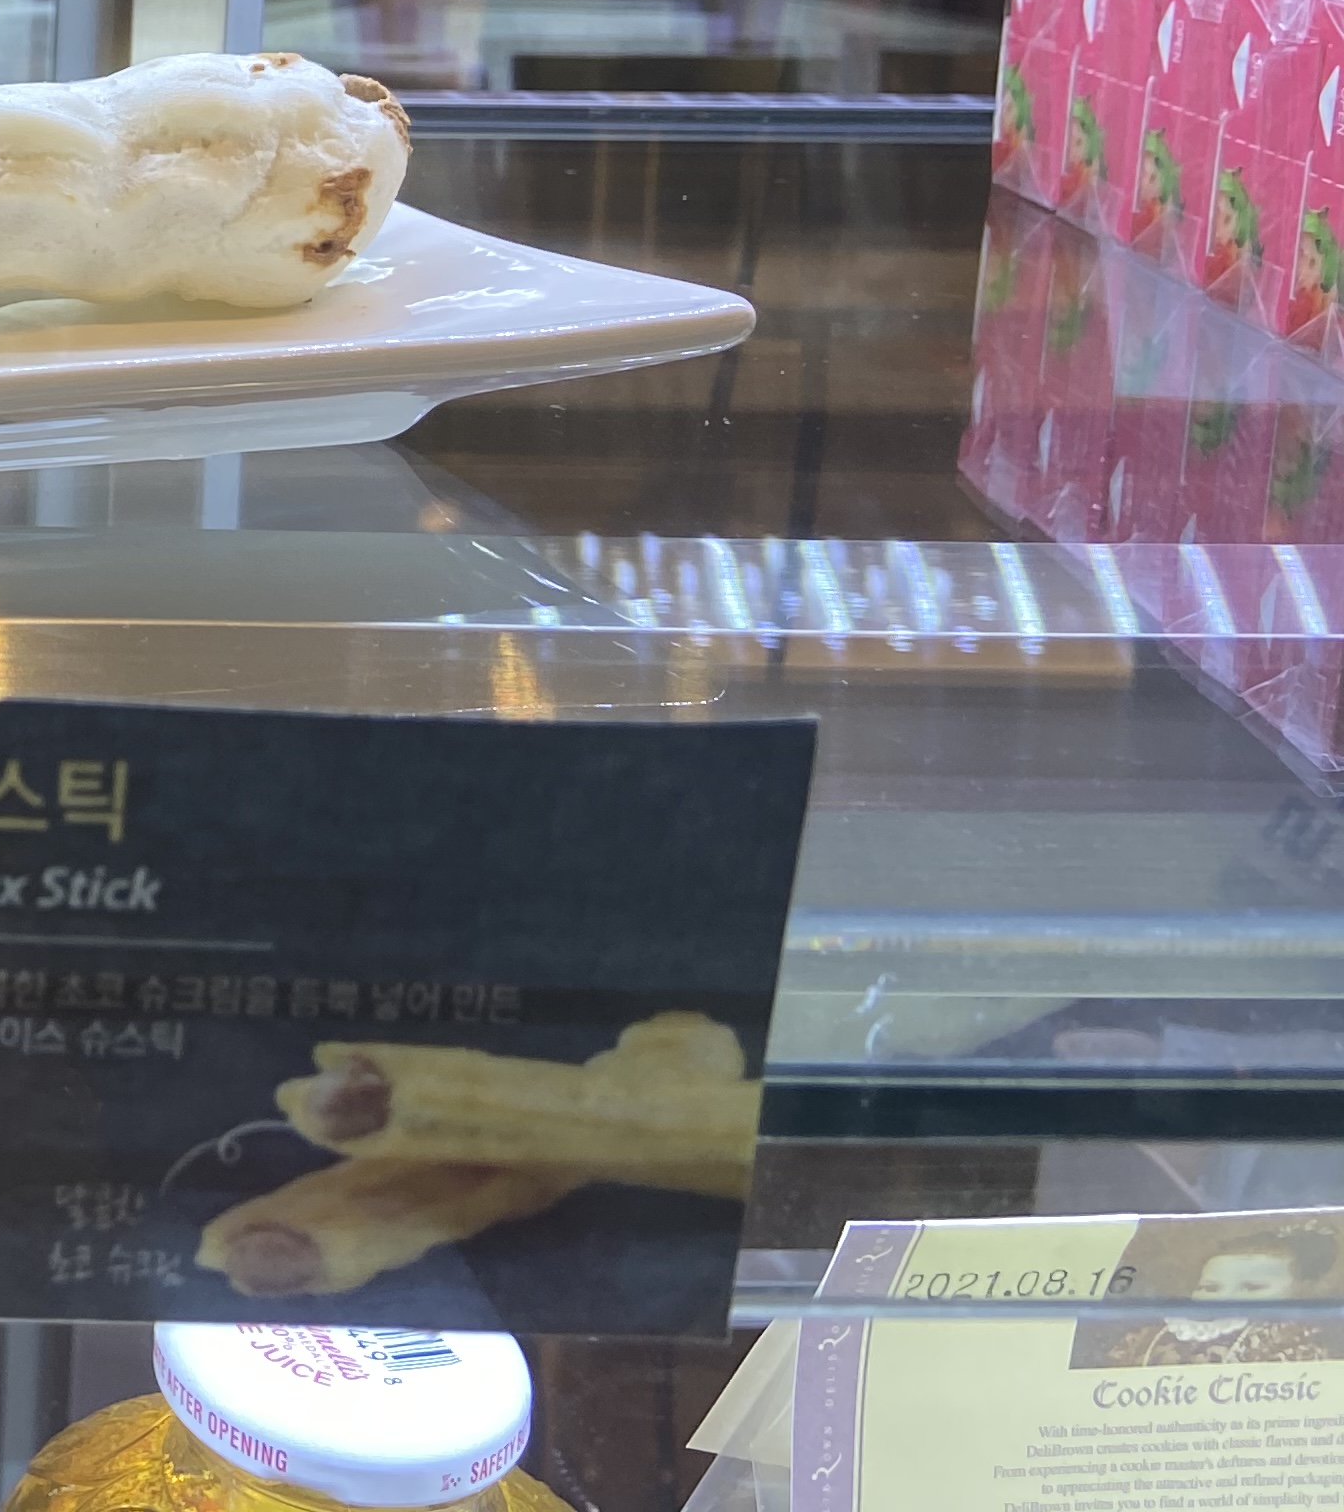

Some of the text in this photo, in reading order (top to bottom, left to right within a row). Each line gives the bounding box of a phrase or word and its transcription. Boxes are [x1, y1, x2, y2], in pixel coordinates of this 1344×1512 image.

[1172, 19, 1185, 64] OPEN
[1247, 51, 1263, 99] OPEN
[37, 865, 161, 910] Stick
[80, 1018, 184, 1061] 슈스틱
[904, 1266, 1138, 1299] 2021.08.16
[250, 1340, 335, 1387] JUICE
[1092, 1371, 1322, 1410] Cookie Classic
[166, 1367, 288, 1473] AFTER OPENING
[1038, 1425, 1068, 1439] With
[1230, 1420, 1243, 1430] as
[1247, 1416, 1261, 1430] its
[469, 1436, 517, 1485] SAFETY
[1141, 1439, 1189, 1453] cookies
[1192, 1438, 1219, 1450] with
[1222, 1435, 1262, 1449] classic
[1265, 1434, 1308, 1448] flavors
[1310, 1433, 1334, 1446] and
[993, 1465, 1026, 1479] From
[1110, 1463, 1118, 1473] a
[1269, 1454, 1292, 1466] and
[1042, 1483, 1053, 1495] to
[1134, 1478, 1153, 1491] the
[1216, 1474, 1238, 1487] and
[1241, 1472, 1284, 1486] refined
[1117, 1499, 1140, 1512] you
[1144, 1497, 1156, 1509] to
[1198, 1494, 1233, 1507] world
[1236, 1493, 1250, 1506] of
[1317, 1491, 1340, 1505] and
